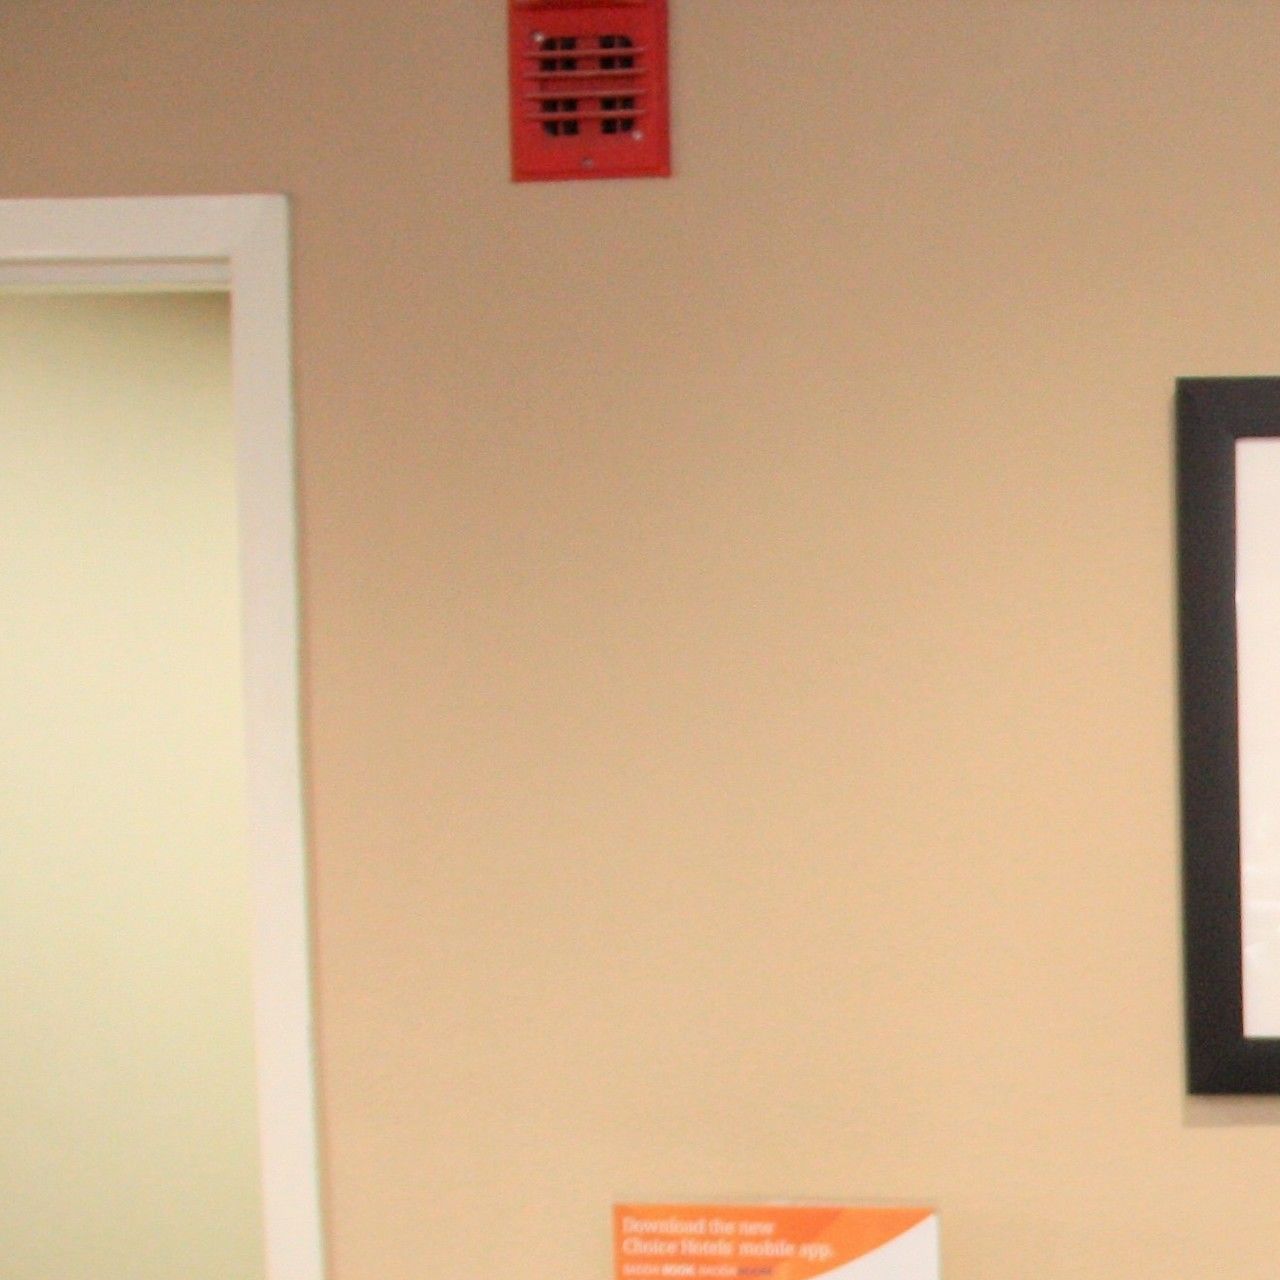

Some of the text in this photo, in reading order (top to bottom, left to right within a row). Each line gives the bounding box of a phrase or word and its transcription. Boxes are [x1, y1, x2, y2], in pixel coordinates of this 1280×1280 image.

[623, 1216, 775, 1236] Download the new
[623, 1237, 679, 1255] Choice
[739, 1241, 796, 1257] mobile
